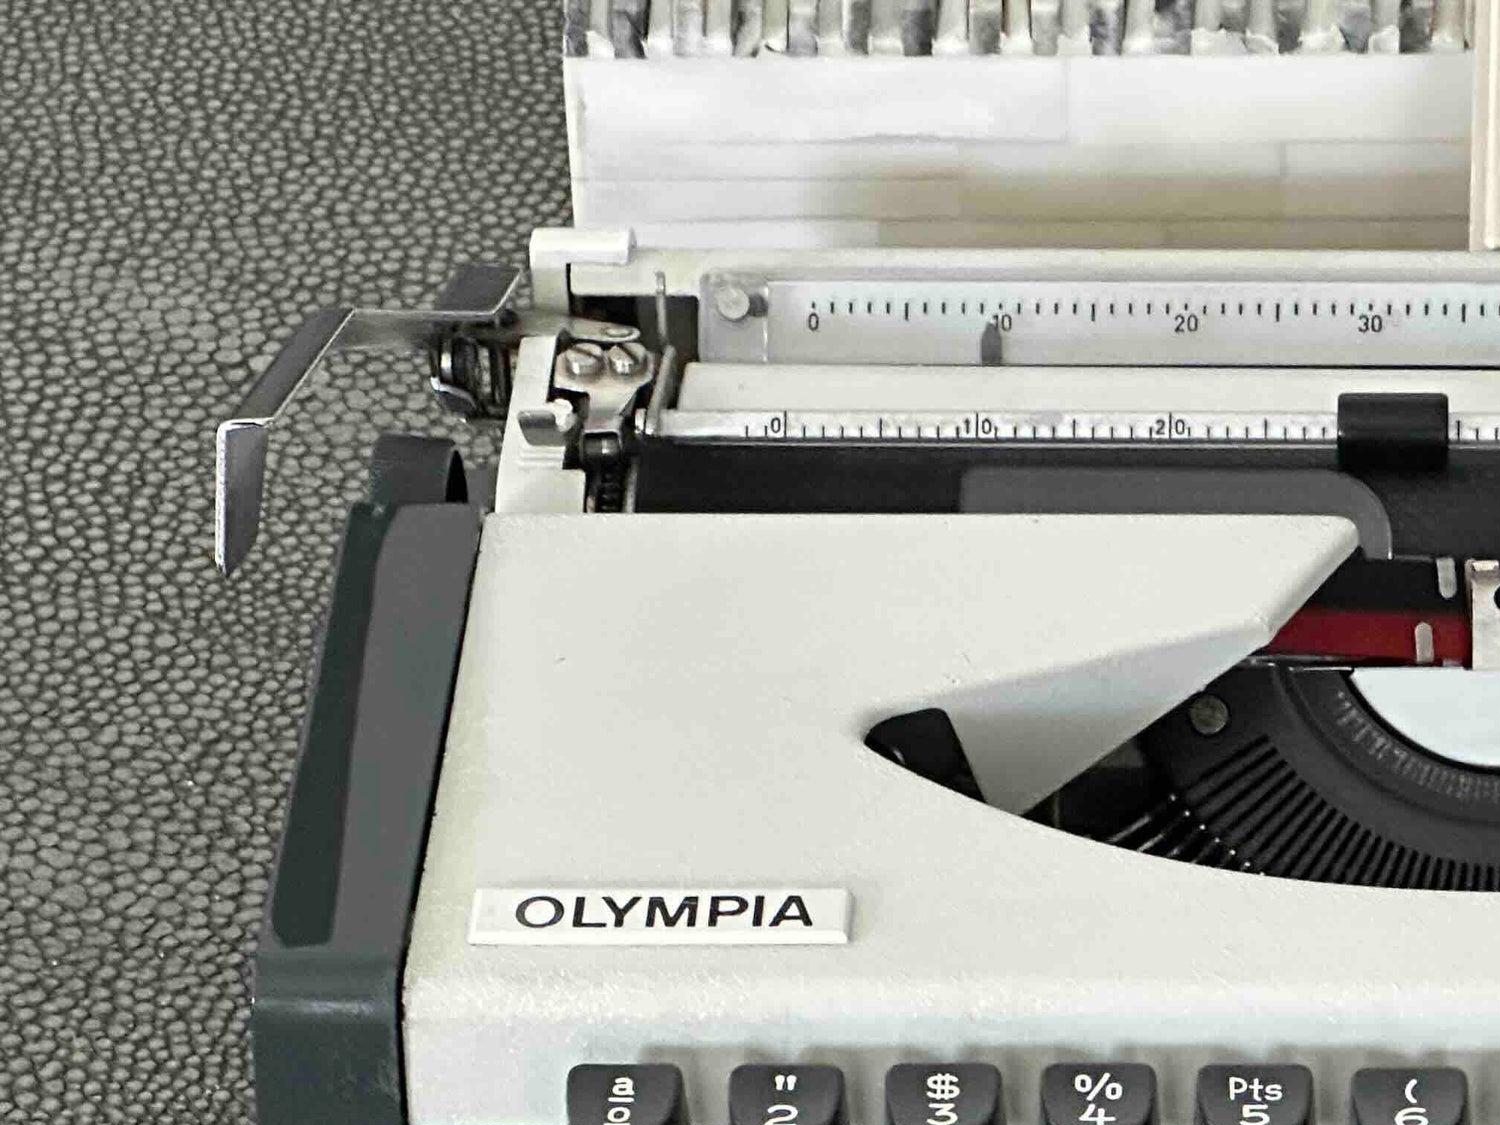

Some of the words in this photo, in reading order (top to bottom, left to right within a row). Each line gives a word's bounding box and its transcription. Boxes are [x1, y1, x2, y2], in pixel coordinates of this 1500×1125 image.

[807, 313, 821, 332] 0
[992, 314, 1013, 332] 10
[1174, 314, 1199, 333] 20
[1358, 314, 1383, 334] 30
[514, 894, 814, 929] OLYMPIA
[926, 1072, 961, 1101] $
[1074, 1072, 1123, 1102] %
[1228, 1076, 1283, 1102] Pts
